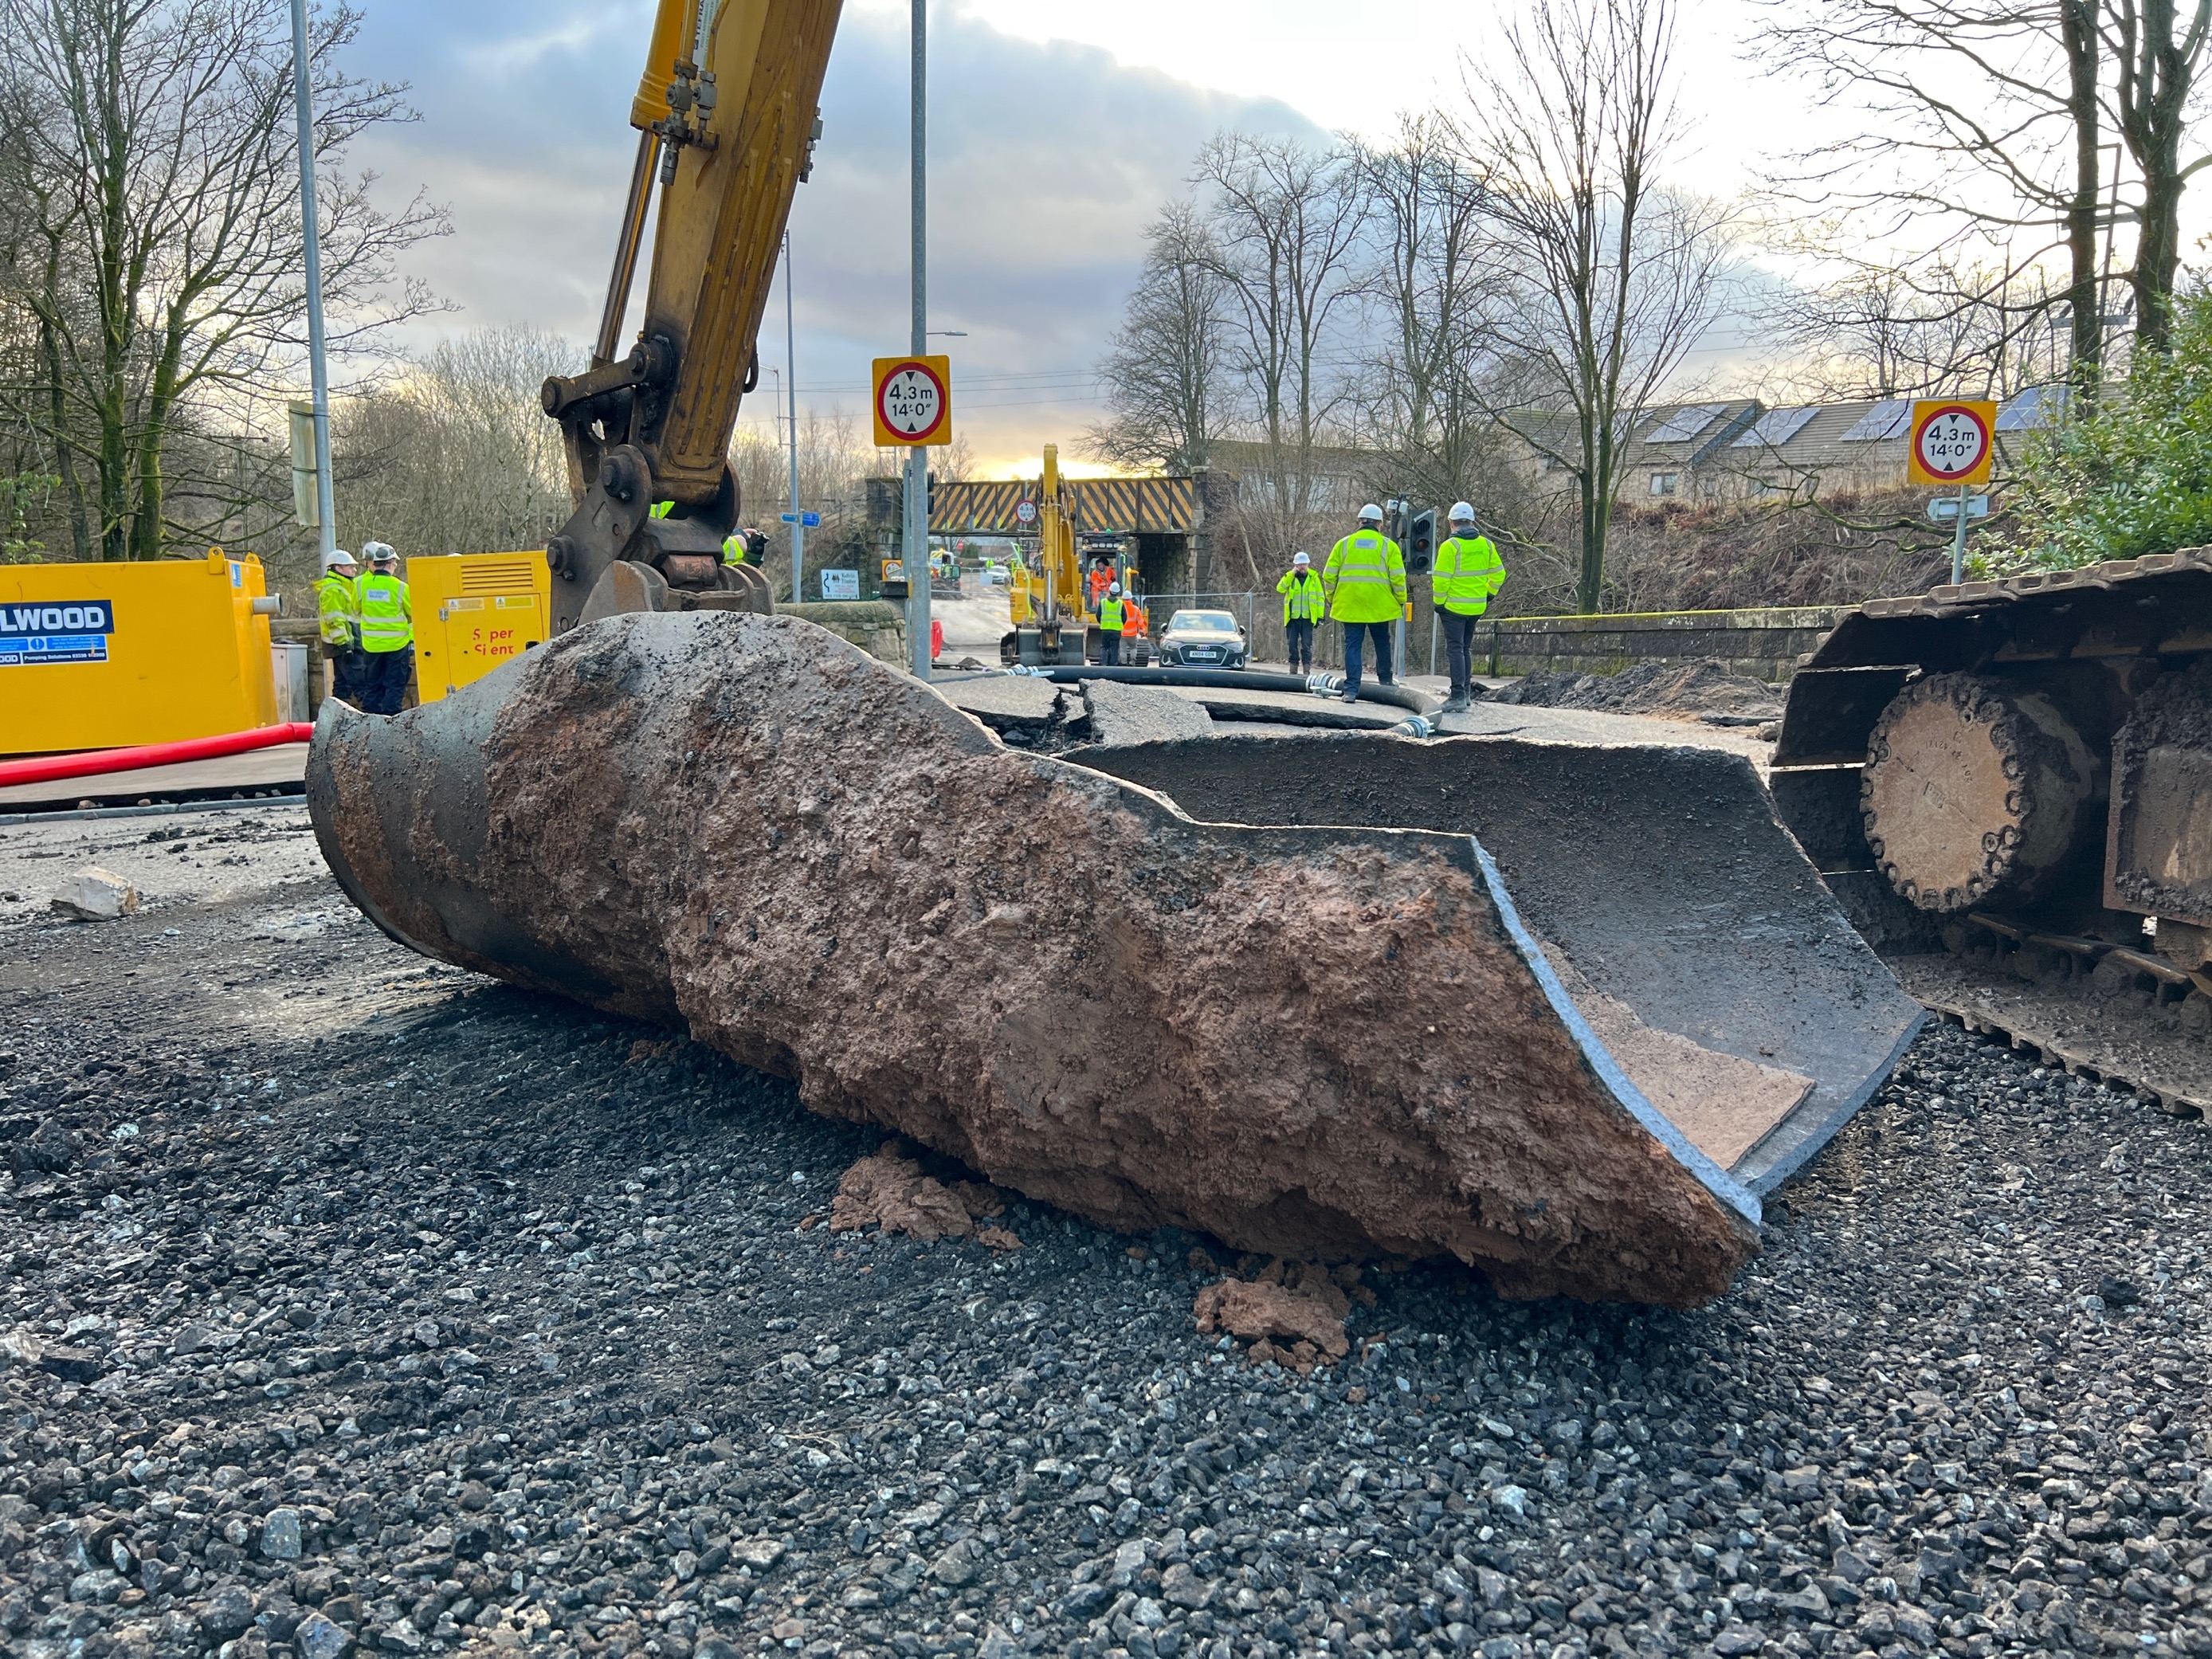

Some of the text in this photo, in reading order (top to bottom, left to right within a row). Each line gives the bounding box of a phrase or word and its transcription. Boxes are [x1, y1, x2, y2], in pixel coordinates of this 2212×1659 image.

[889, 384, 932, 400] 4.3 m
[1928, 425, 1975, 441] 4.3 m
[473, 628, 514, 643] Sper
